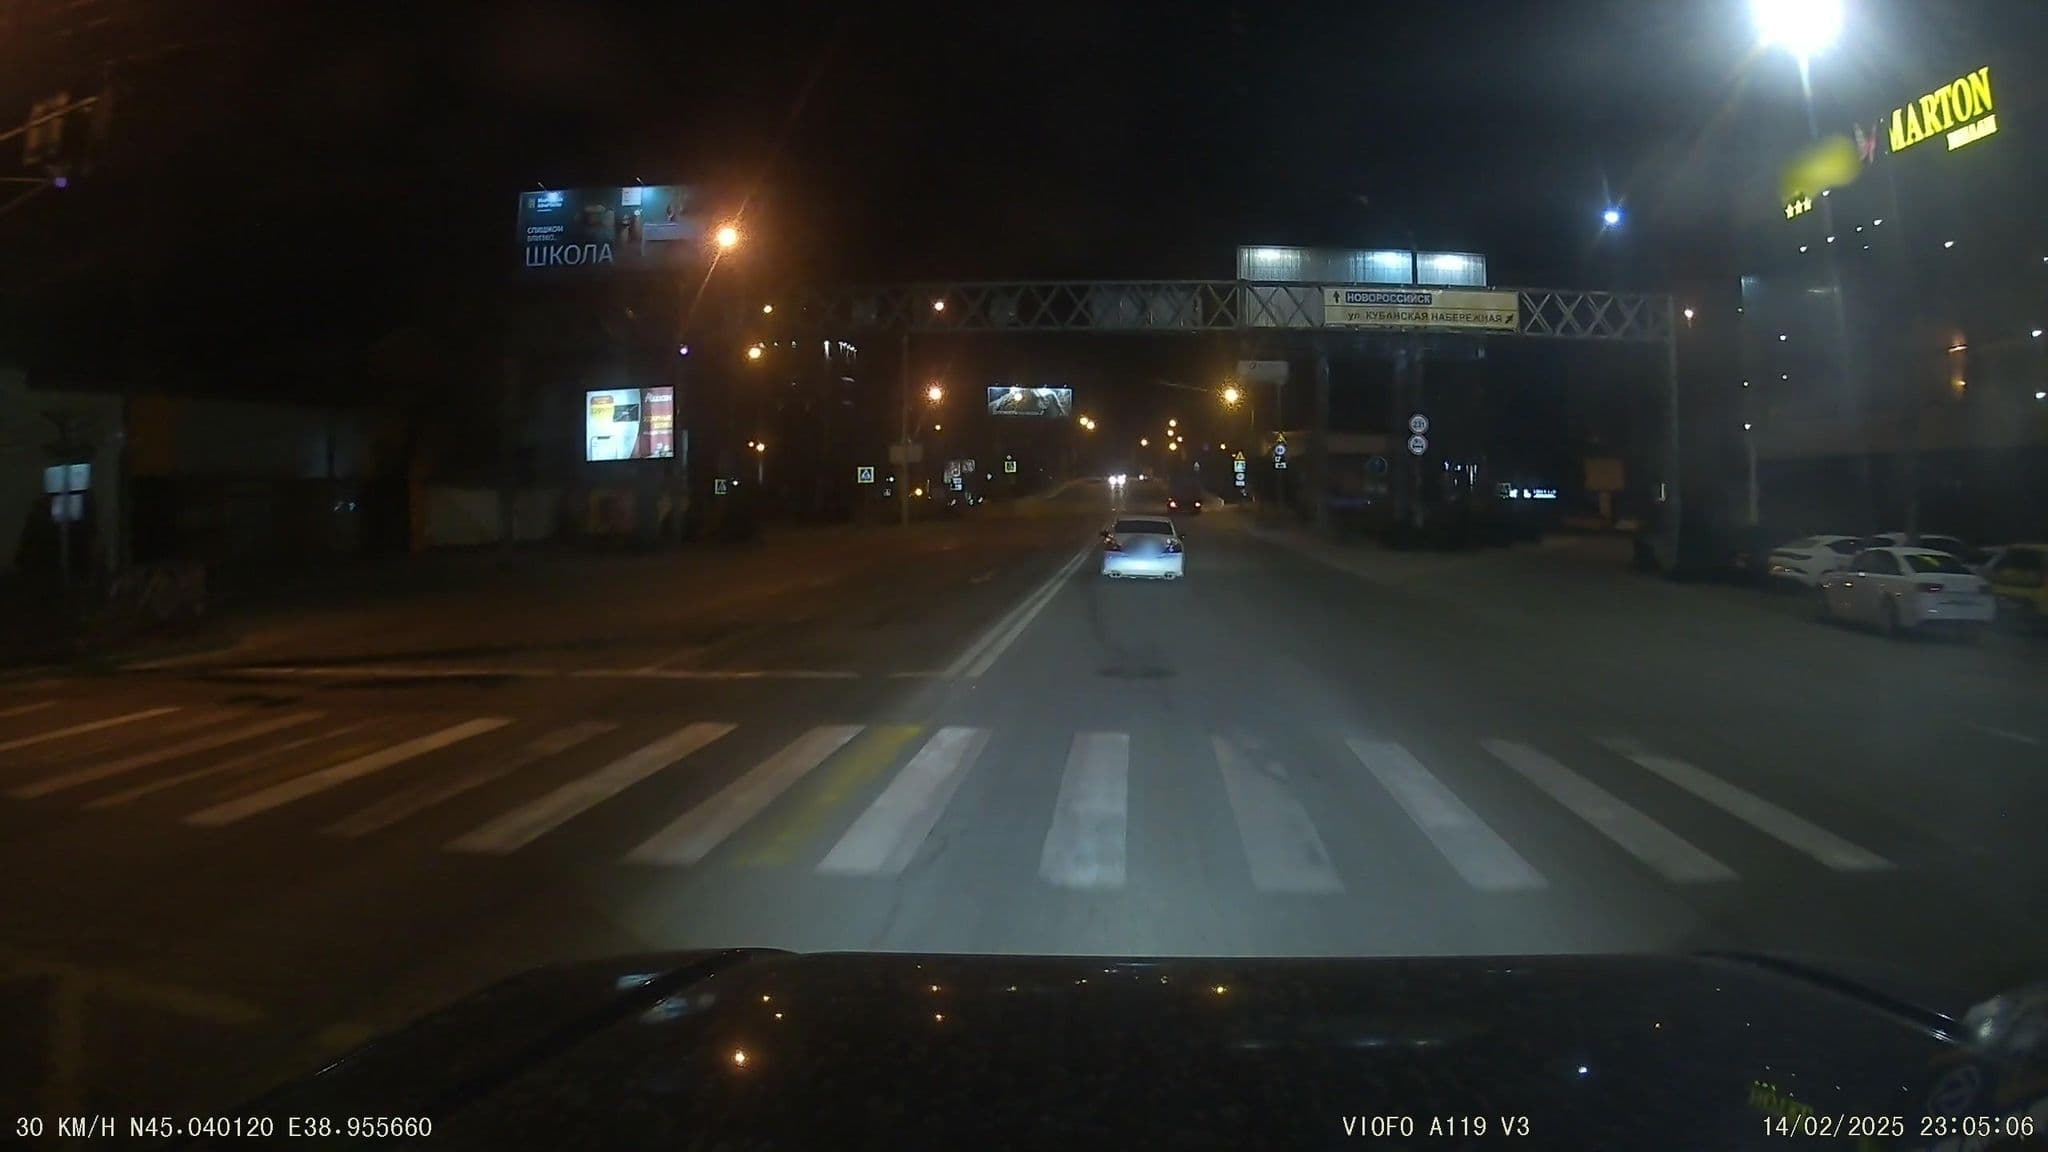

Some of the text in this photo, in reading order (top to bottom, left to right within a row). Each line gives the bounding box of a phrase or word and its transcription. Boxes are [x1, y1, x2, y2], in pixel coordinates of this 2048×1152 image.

[1888, 66, 1994, 153] MARTON
[525, 243, 614, 267] ШКОЛА
[1346, 292, 1431, 304] НОВОРОССИЙСК
[1365, 311, 1429, 321] КУБАНСКАЯ
[1431, 312, 1502, 322] НАБЕРЕЖНАЯ
